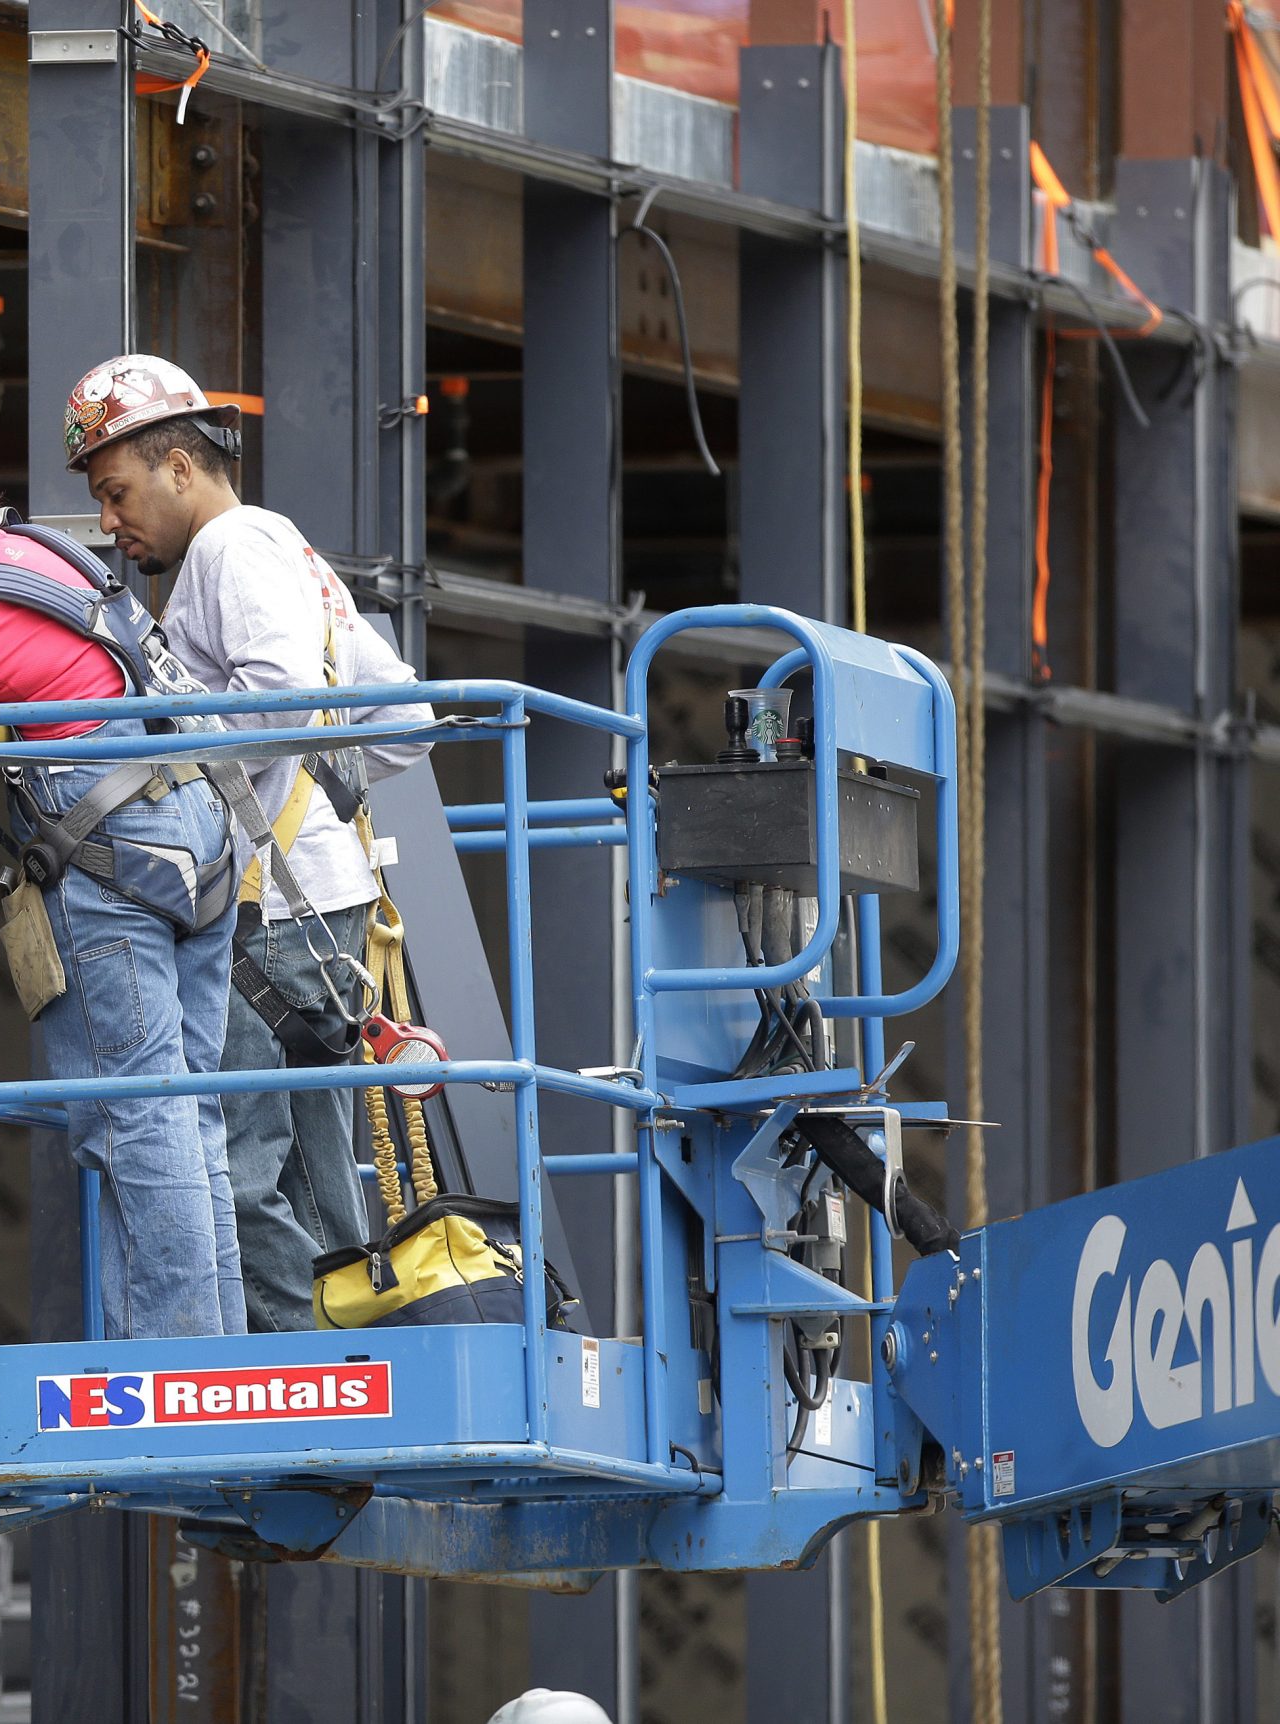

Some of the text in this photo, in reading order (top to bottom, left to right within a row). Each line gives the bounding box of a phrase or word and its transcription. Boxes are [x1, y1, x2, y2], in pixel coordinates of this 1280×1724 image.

[111, 405, 165, 431] IRONWRKERS
[39, 1376, 145, 1428] NES
[164, 1374, 370, 1415] Rentals
